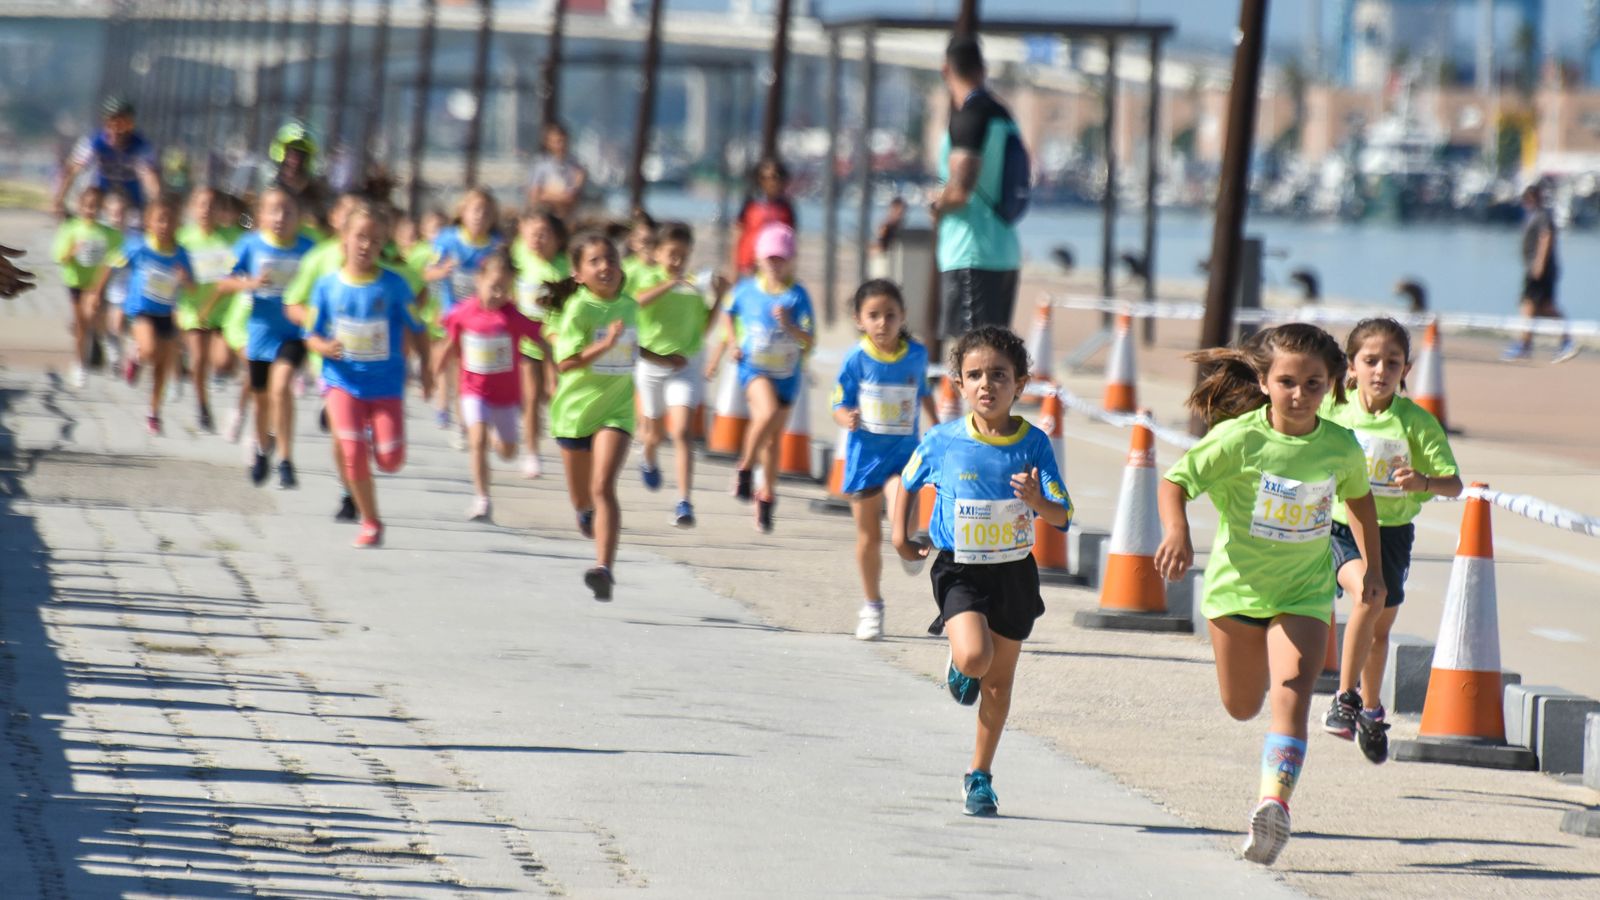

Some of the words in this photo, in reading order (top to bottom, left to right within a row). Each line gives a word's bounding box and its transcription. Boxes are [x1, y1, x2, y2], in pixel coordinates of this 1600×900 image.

[1264, 480, 1281, 493] XXI
[959, 505, 974, 516] XXI
[1263, 497, 1316, 528] 1497
[961, 522, 1014, 546] 1098
